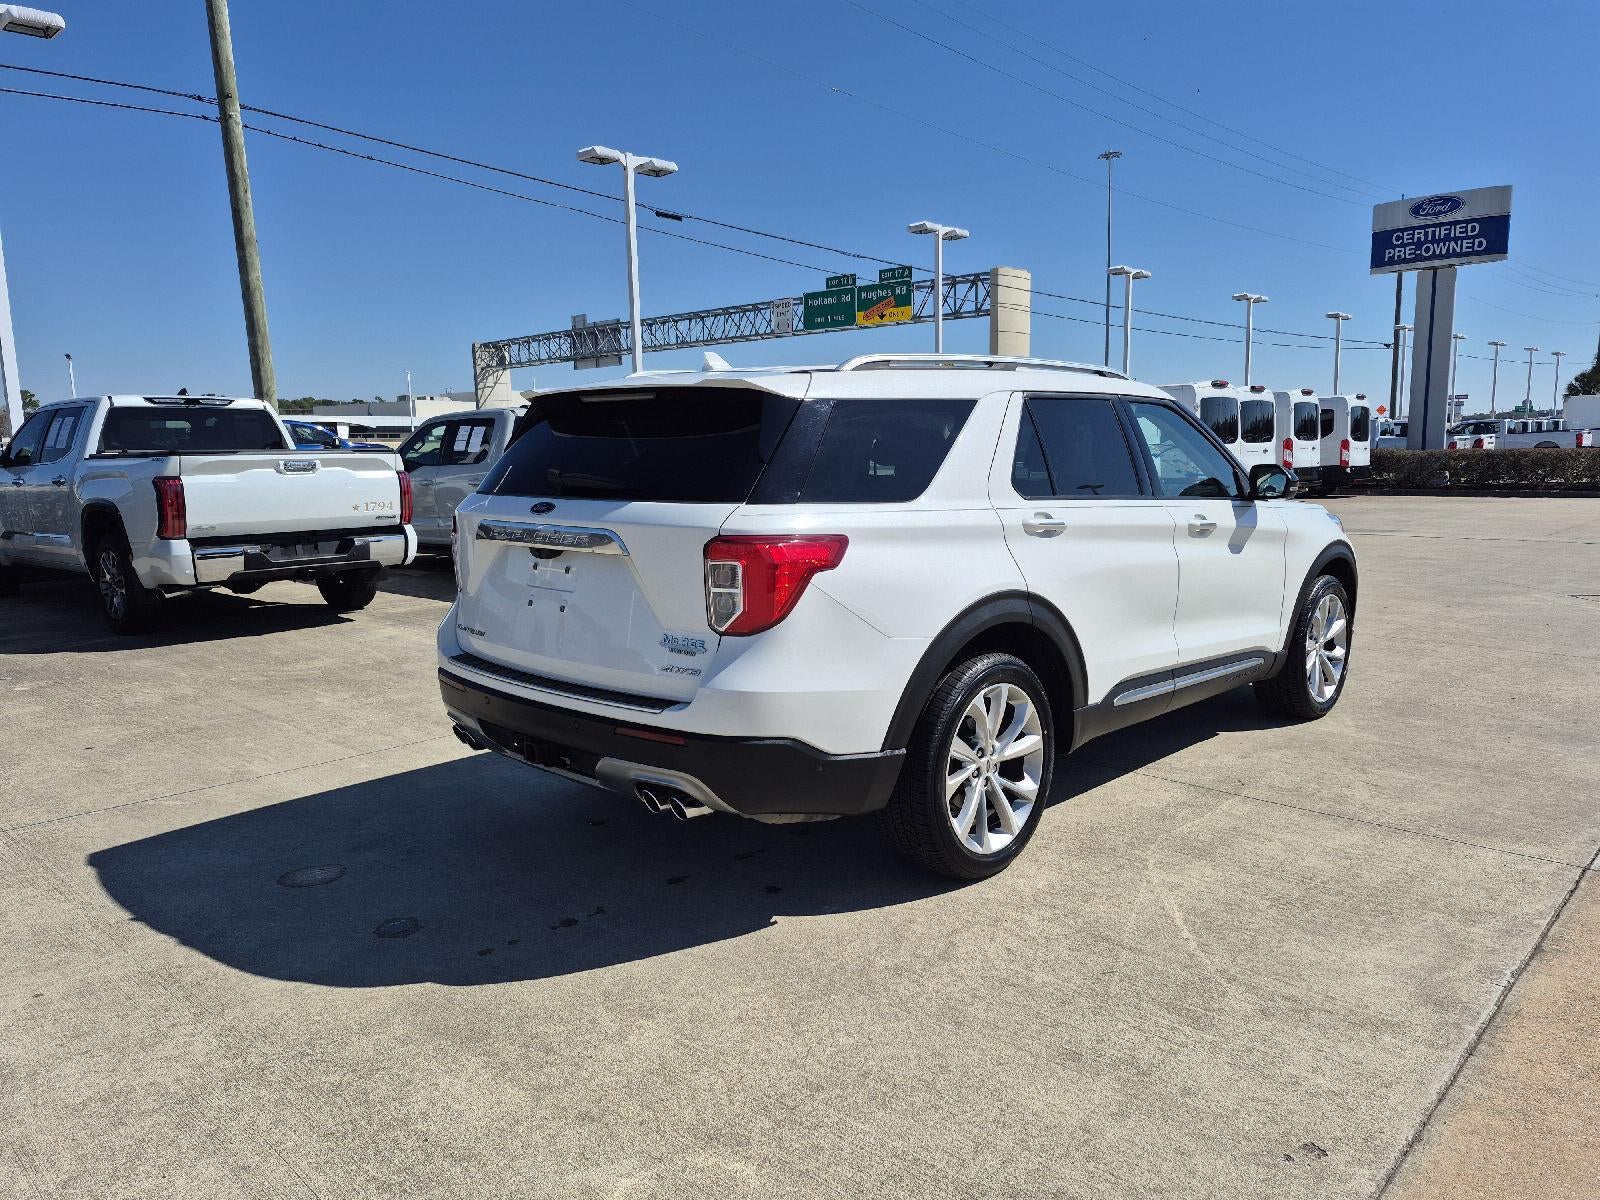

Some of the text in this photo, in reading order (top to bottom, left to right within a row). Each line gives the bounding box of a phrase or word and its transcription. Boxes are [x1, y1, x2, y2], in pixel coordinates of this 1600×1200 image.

[1420, 200, 1452, 215] Ford
[1392, 222, 1480, 245] CERTIFIED
[1384, 237, 1487, 262] PRE-OWNED
[808, 293, 851, 307] Holland Rd
[861, 285, 907, 300] Hughes Rd
[363, 501, 394, 512] 1794
[490, 527, 590, 546] EXPLORER
